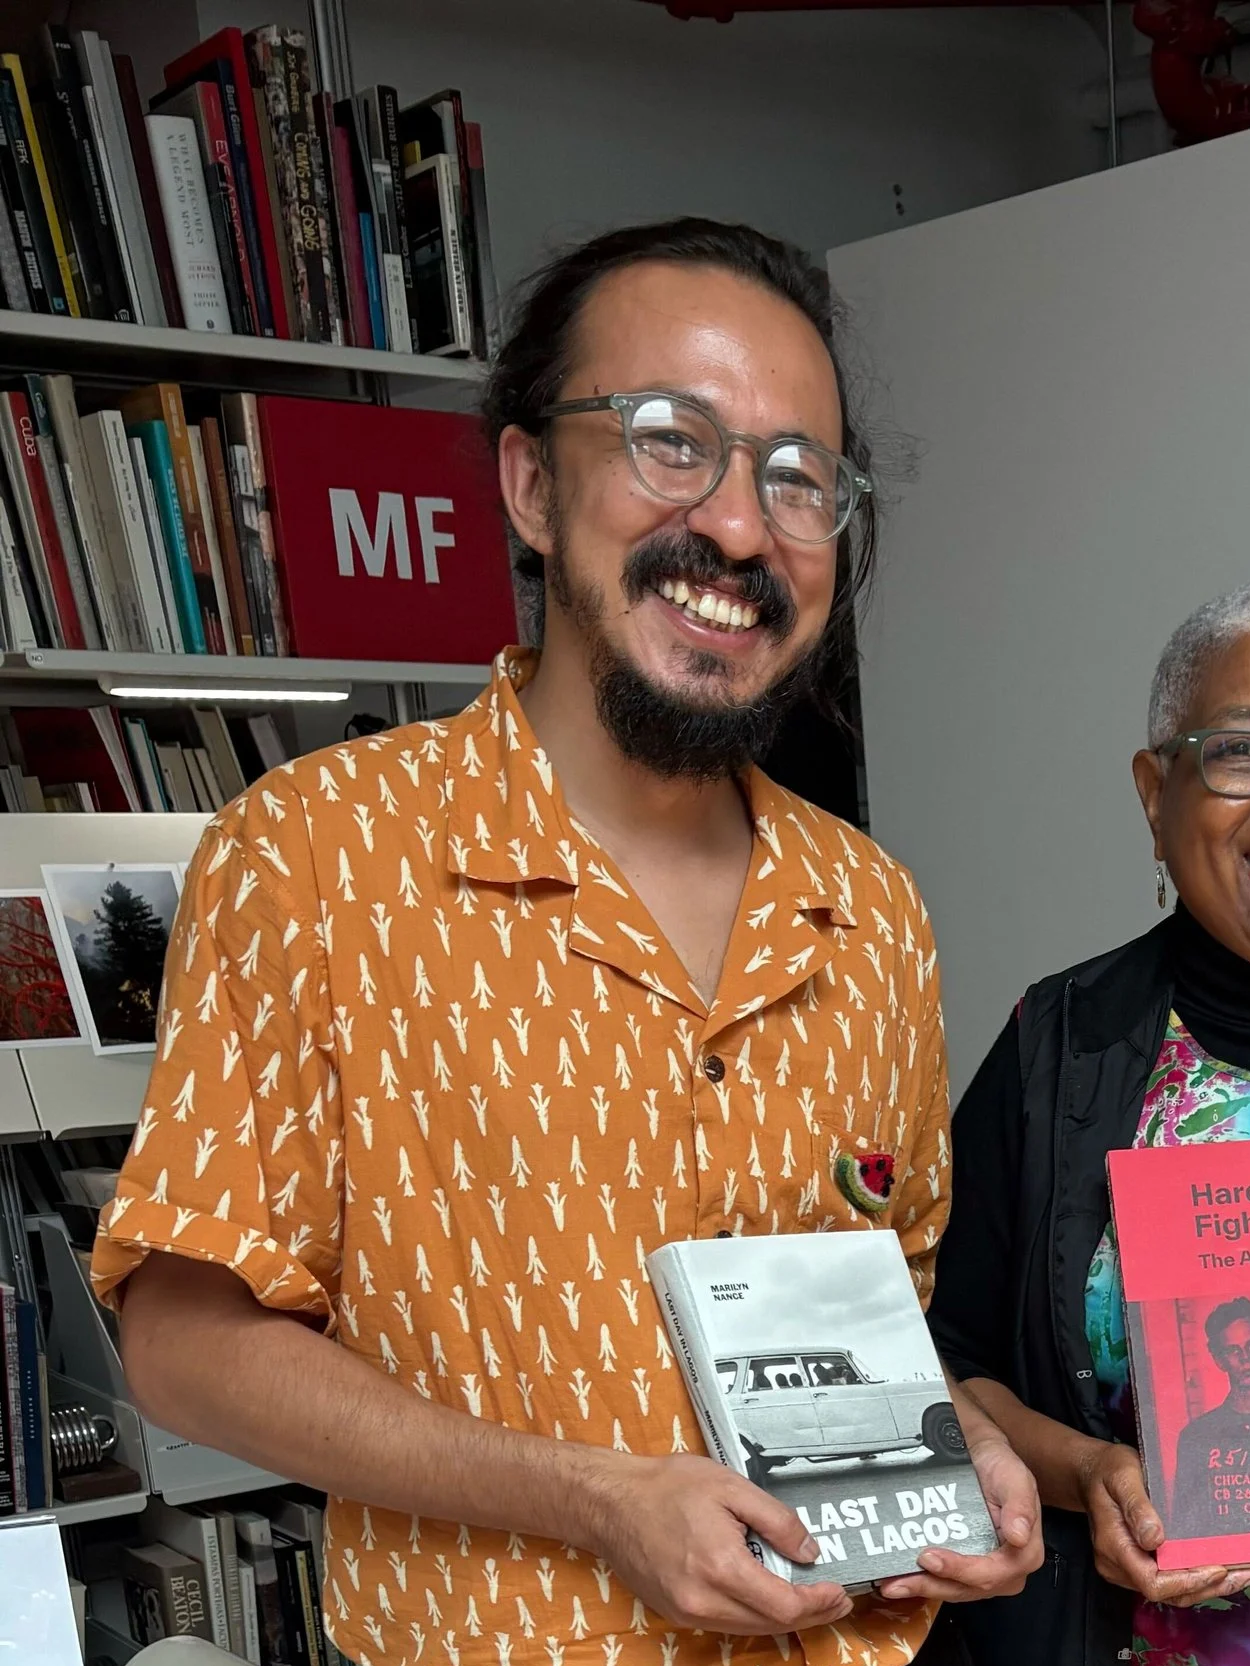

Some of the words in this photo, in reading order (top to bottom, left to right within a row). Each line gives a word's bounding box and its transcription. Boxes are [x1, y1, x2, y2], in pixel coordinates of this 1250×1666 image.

[15, 139, 30, 164] RFK
[19, 416, 38, 456] Cuba
[328, 487, 456, 584] MF
[1199, 1250, 1235, 1270] The
[710, 1282, 749, 1294] MARILYN
[713, 1292, 745, 1302] NANCE
[665, 1292, 677, 1316] LAST
[673, 1317, 683, 1337] DAY
[680, 1338, 688, 1349] IN
[684, 1350, 699, 1384] LAGOS
[704, 1410, 722, 1450] MARILYN
[796, 1495, 880, 1533] LAST
[897, 1482, 960, 1516] DAY
[863, 1512, 969, 1559] LAGOS
[170, 1575, 192, 1634] BEATON
[185, 1579, 205, 1628] CECIL
